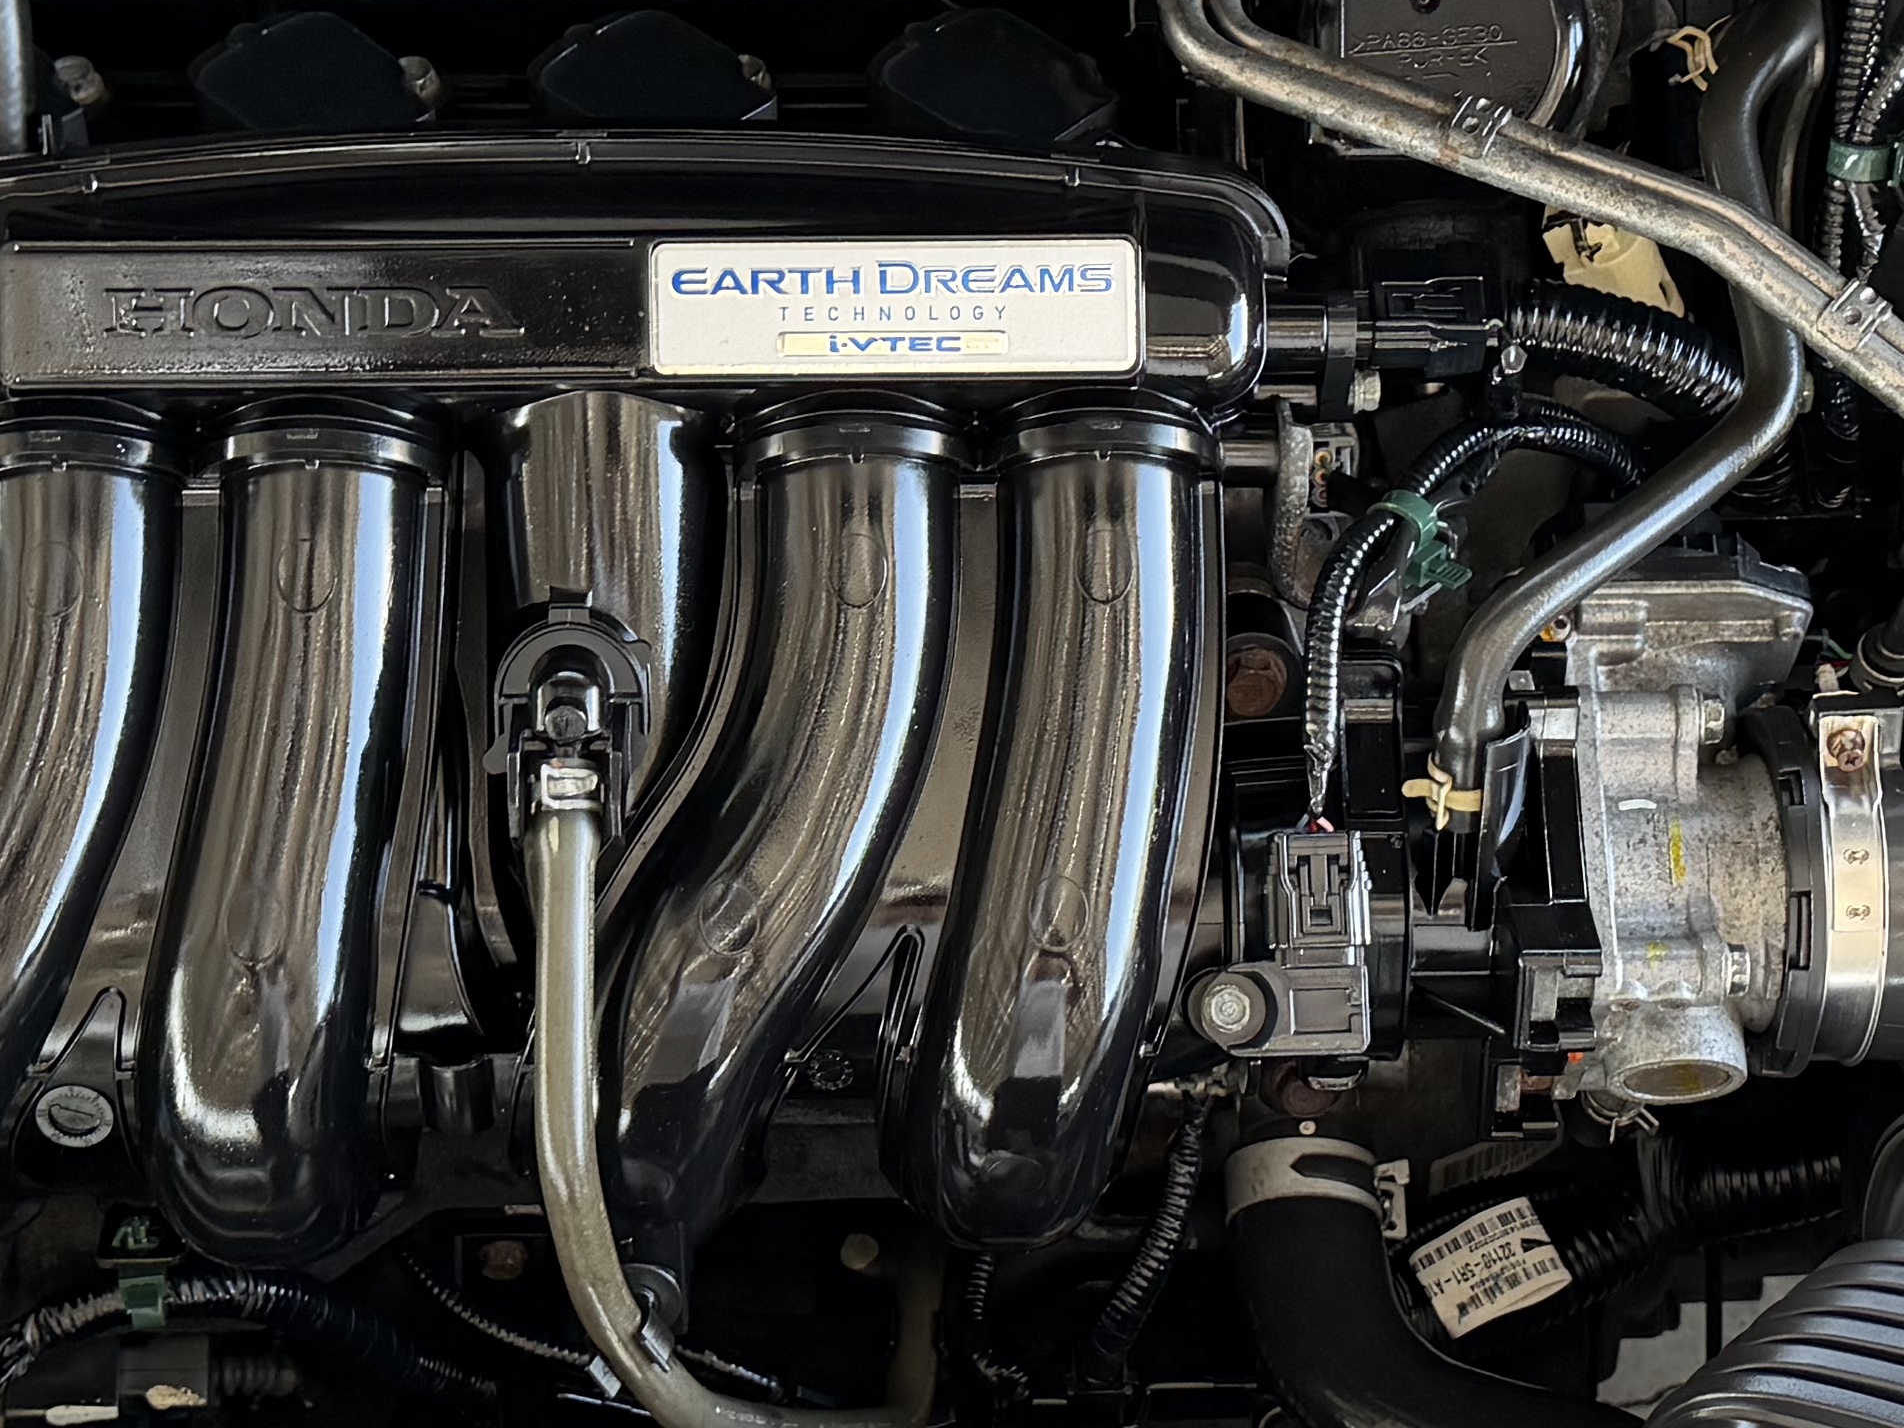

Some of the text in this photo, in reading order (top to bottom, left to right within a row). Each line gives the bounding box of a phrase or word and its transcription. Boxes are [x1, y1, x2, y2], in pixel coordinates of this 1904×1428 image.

[671, 258, 1116, 298] EARTH DREAMS
[102, 284, 526, 339] HONDA
[778, 304, 1008, 323] TECHNOLOGY
